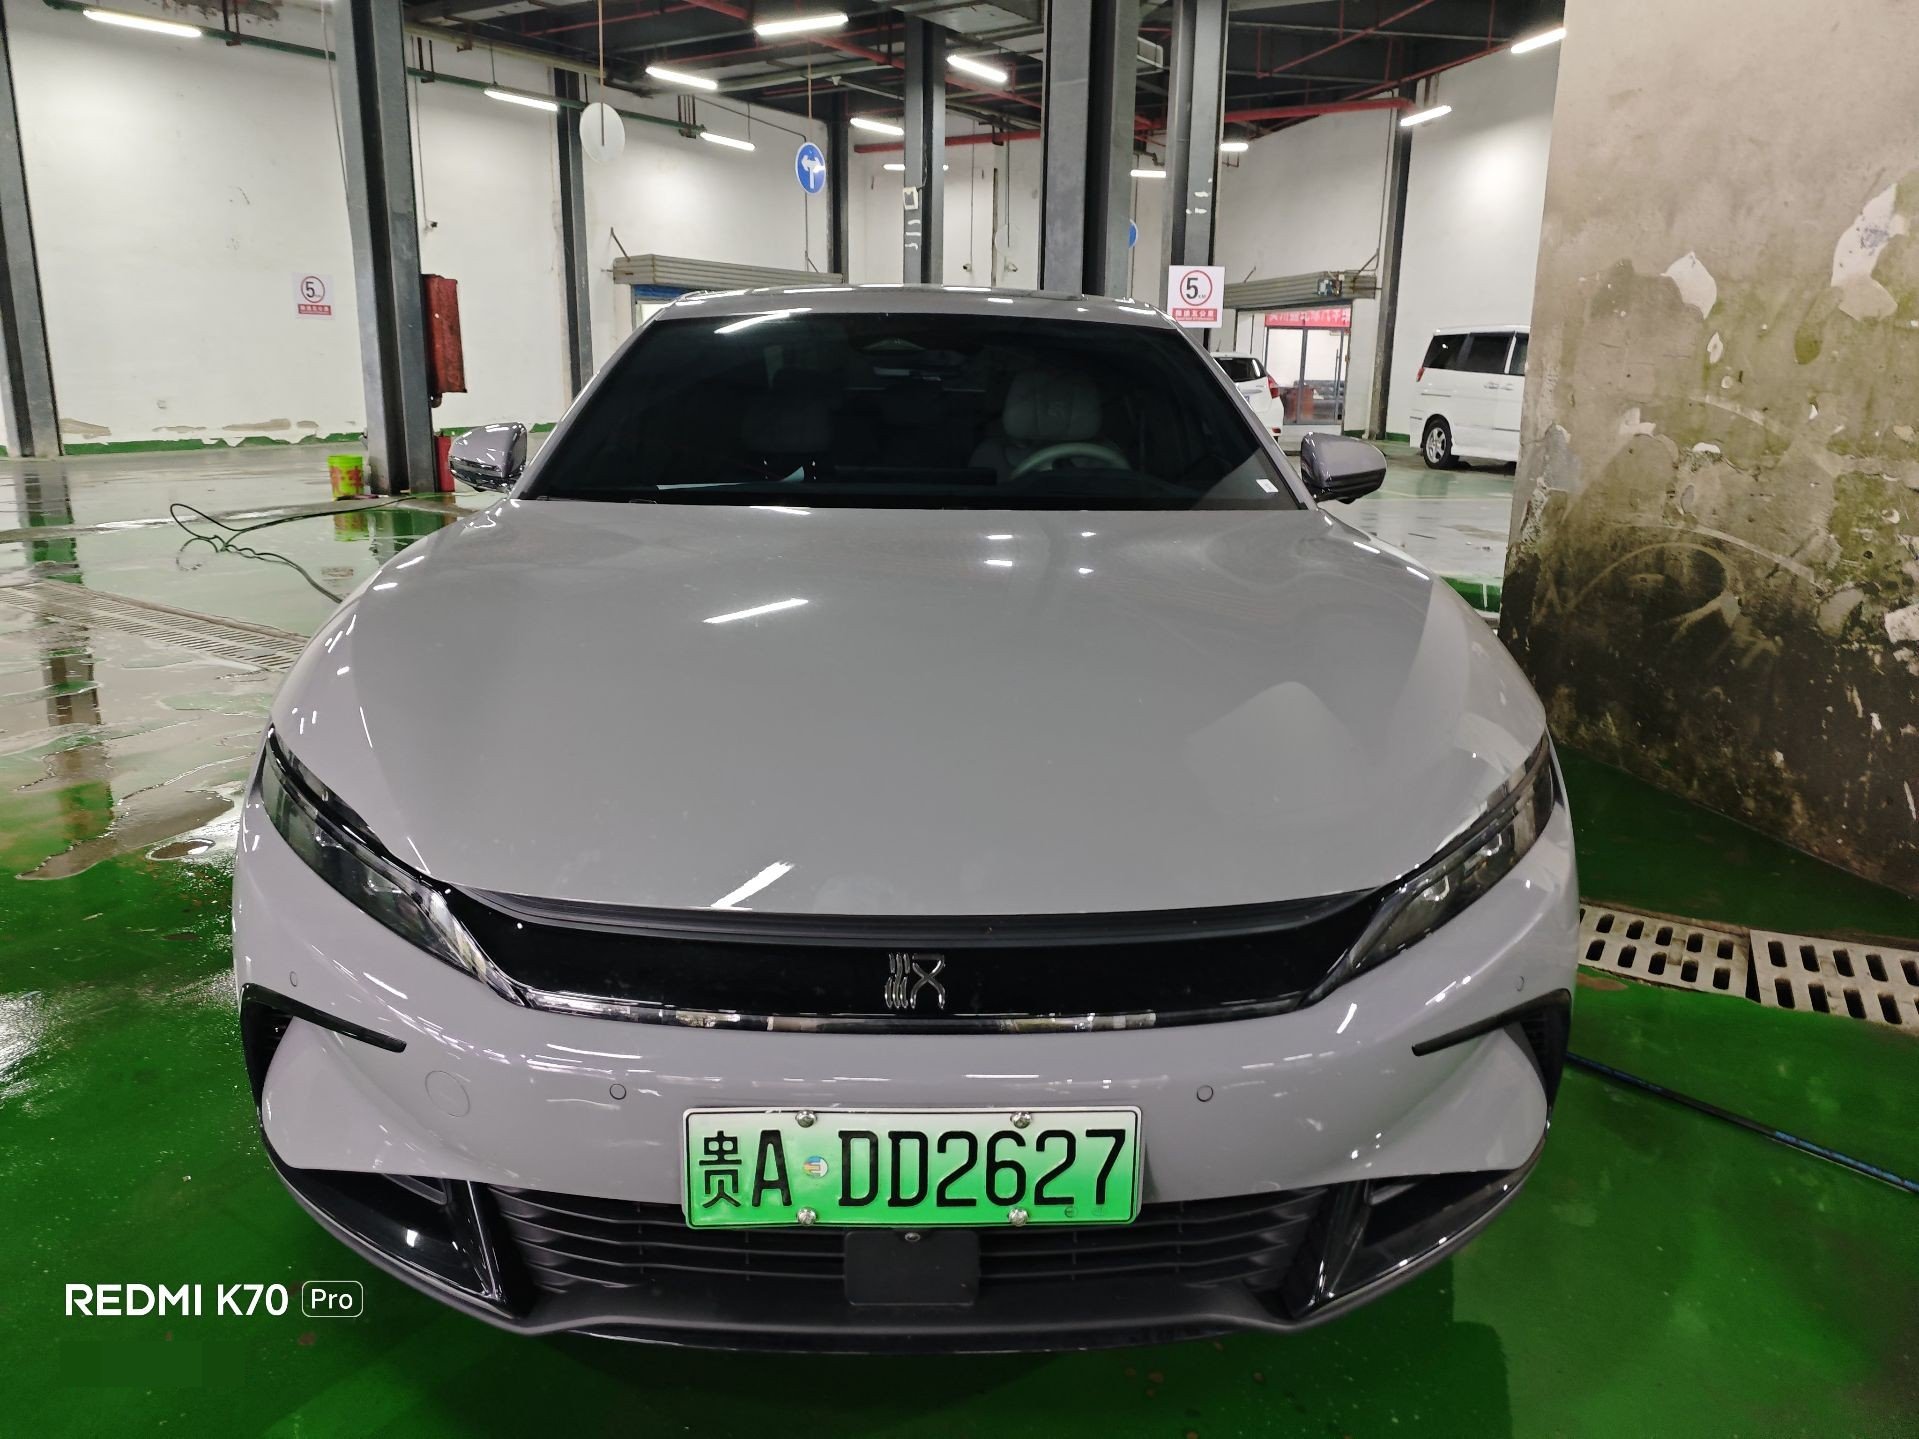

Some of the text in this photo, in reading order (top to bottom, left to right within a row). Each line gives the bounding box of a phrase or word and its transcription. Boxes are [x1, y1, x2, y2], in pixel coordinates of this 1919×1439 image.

[306, 281, 315, 298] 5
[1186, 277, 1199, 299] 5
[838, 1129, 1126, 1207] DD2627
